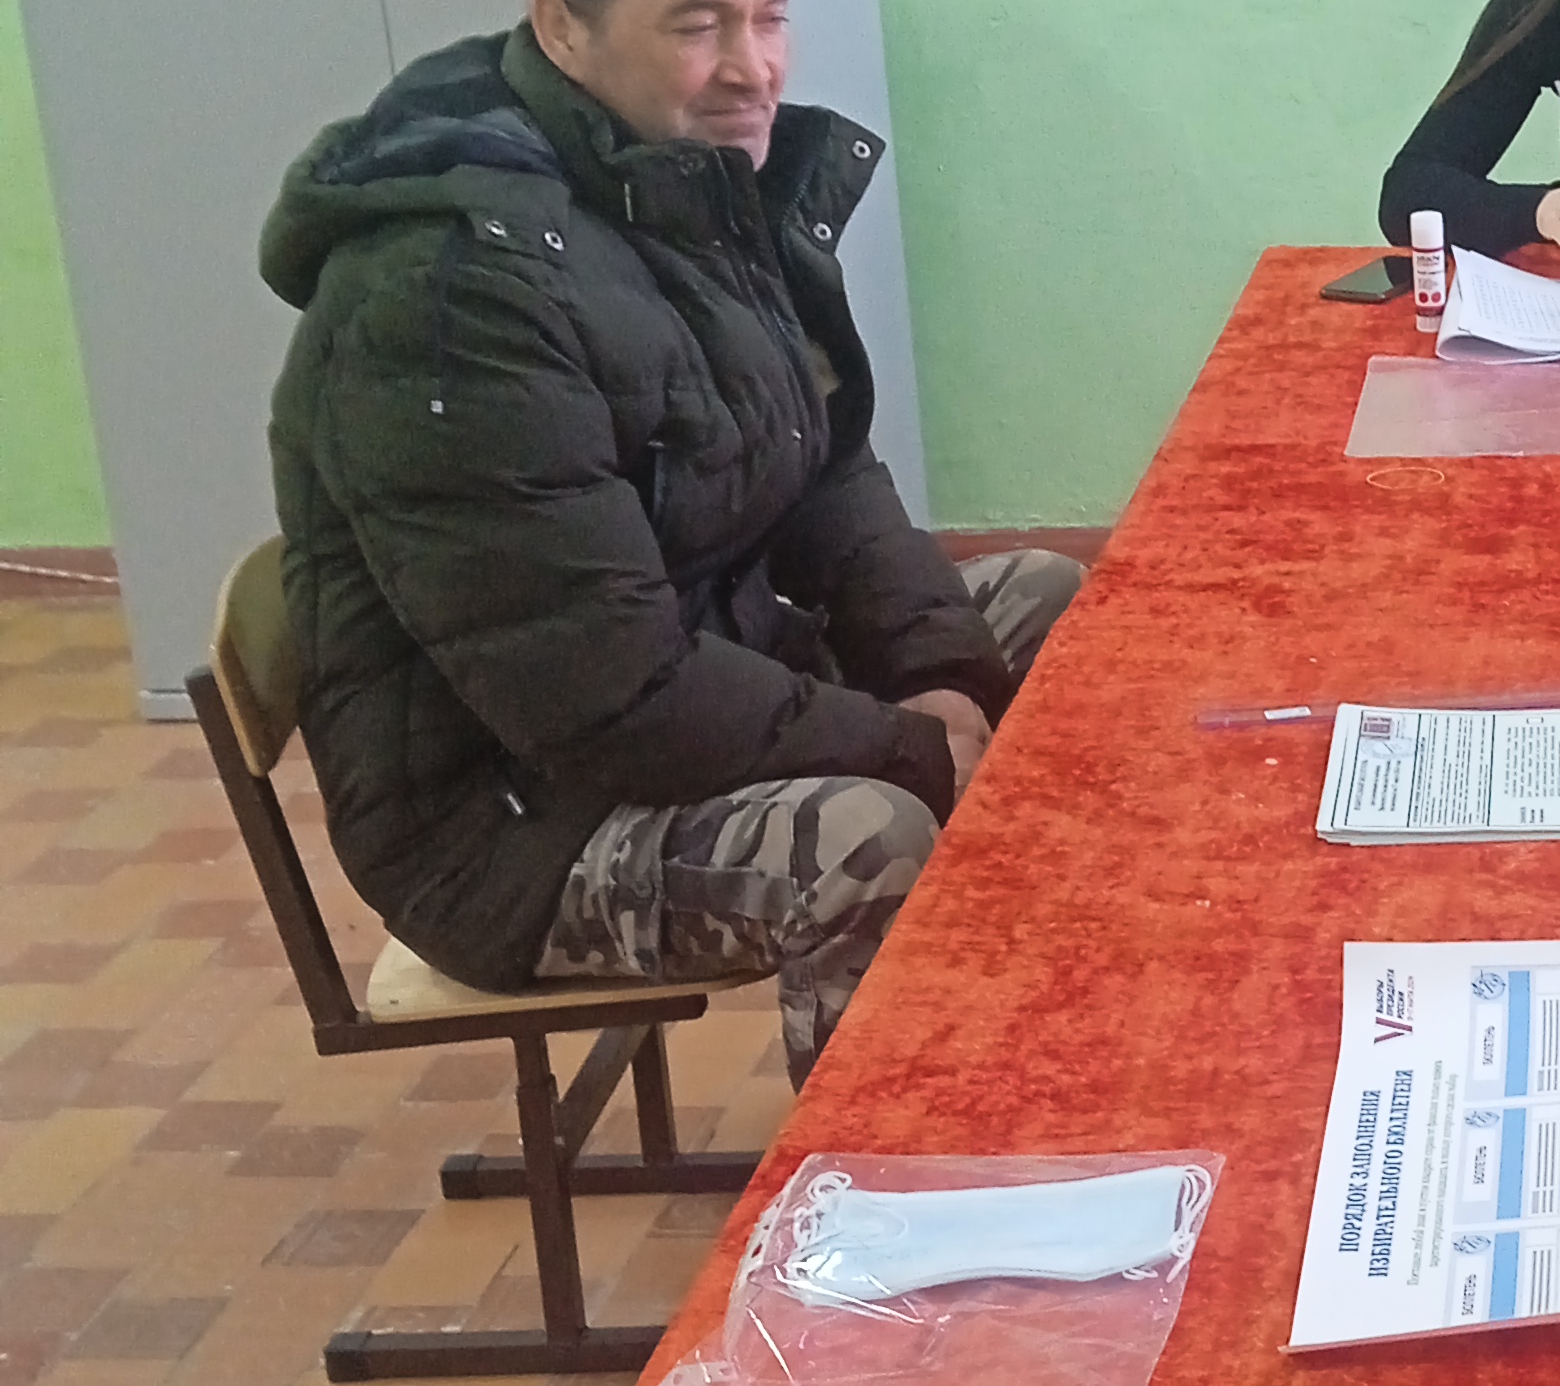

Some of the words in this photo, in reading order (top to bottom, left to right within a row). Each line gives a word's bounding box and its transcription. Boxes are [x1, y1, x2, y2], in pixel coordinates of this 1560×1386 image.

[1350, 1090, 1381, 1180] ЗАПОЛНЕНИЯ
[1368, 1149, 1403, 1277] ИЗБИРАТЕЛЬНОГО
[1386, 1070, 1414, 1146] БЮЛЛЕТЕНЯ
[1339, 1182, 1368, 1252] ПОРЯДОК
